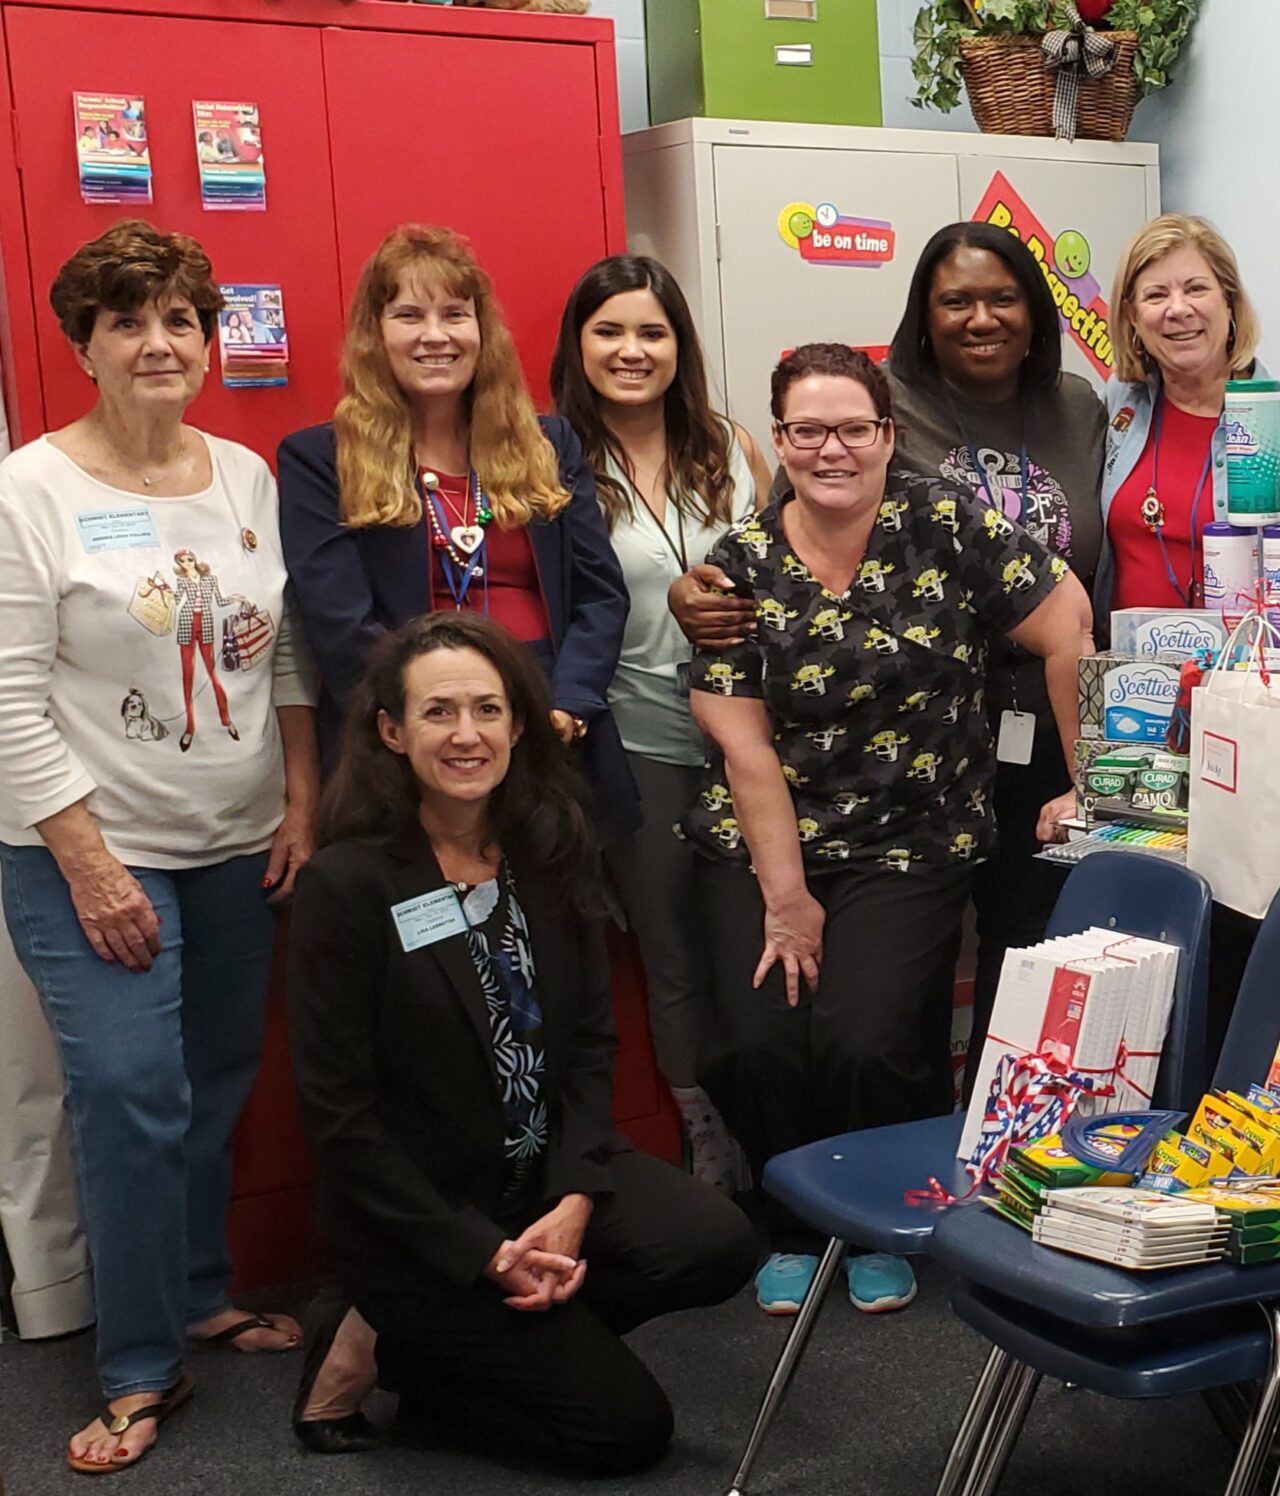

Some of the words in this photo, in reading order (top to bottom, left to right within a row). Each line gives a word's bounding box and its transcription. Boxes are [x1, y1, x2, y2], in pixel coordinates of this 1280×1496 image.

[812, 229, 832, 248] be
[833, 236, 852, 250] on
[854, 232, 889, 252] time
[220, 286, 235, 294] Get
[1142, 627, 1211, 656] Scotties
[1110, 673, 1182, 703] Scotties
[1092, 776, 1122, 788] CURAD
[1144, 773, 1174, 784] CURAD
[1132, 792, 1171, 807] CAMO
[1244, 1126, 1267, 1149] Crayola
[1156, 1147, 1180, 1167] Crayola
